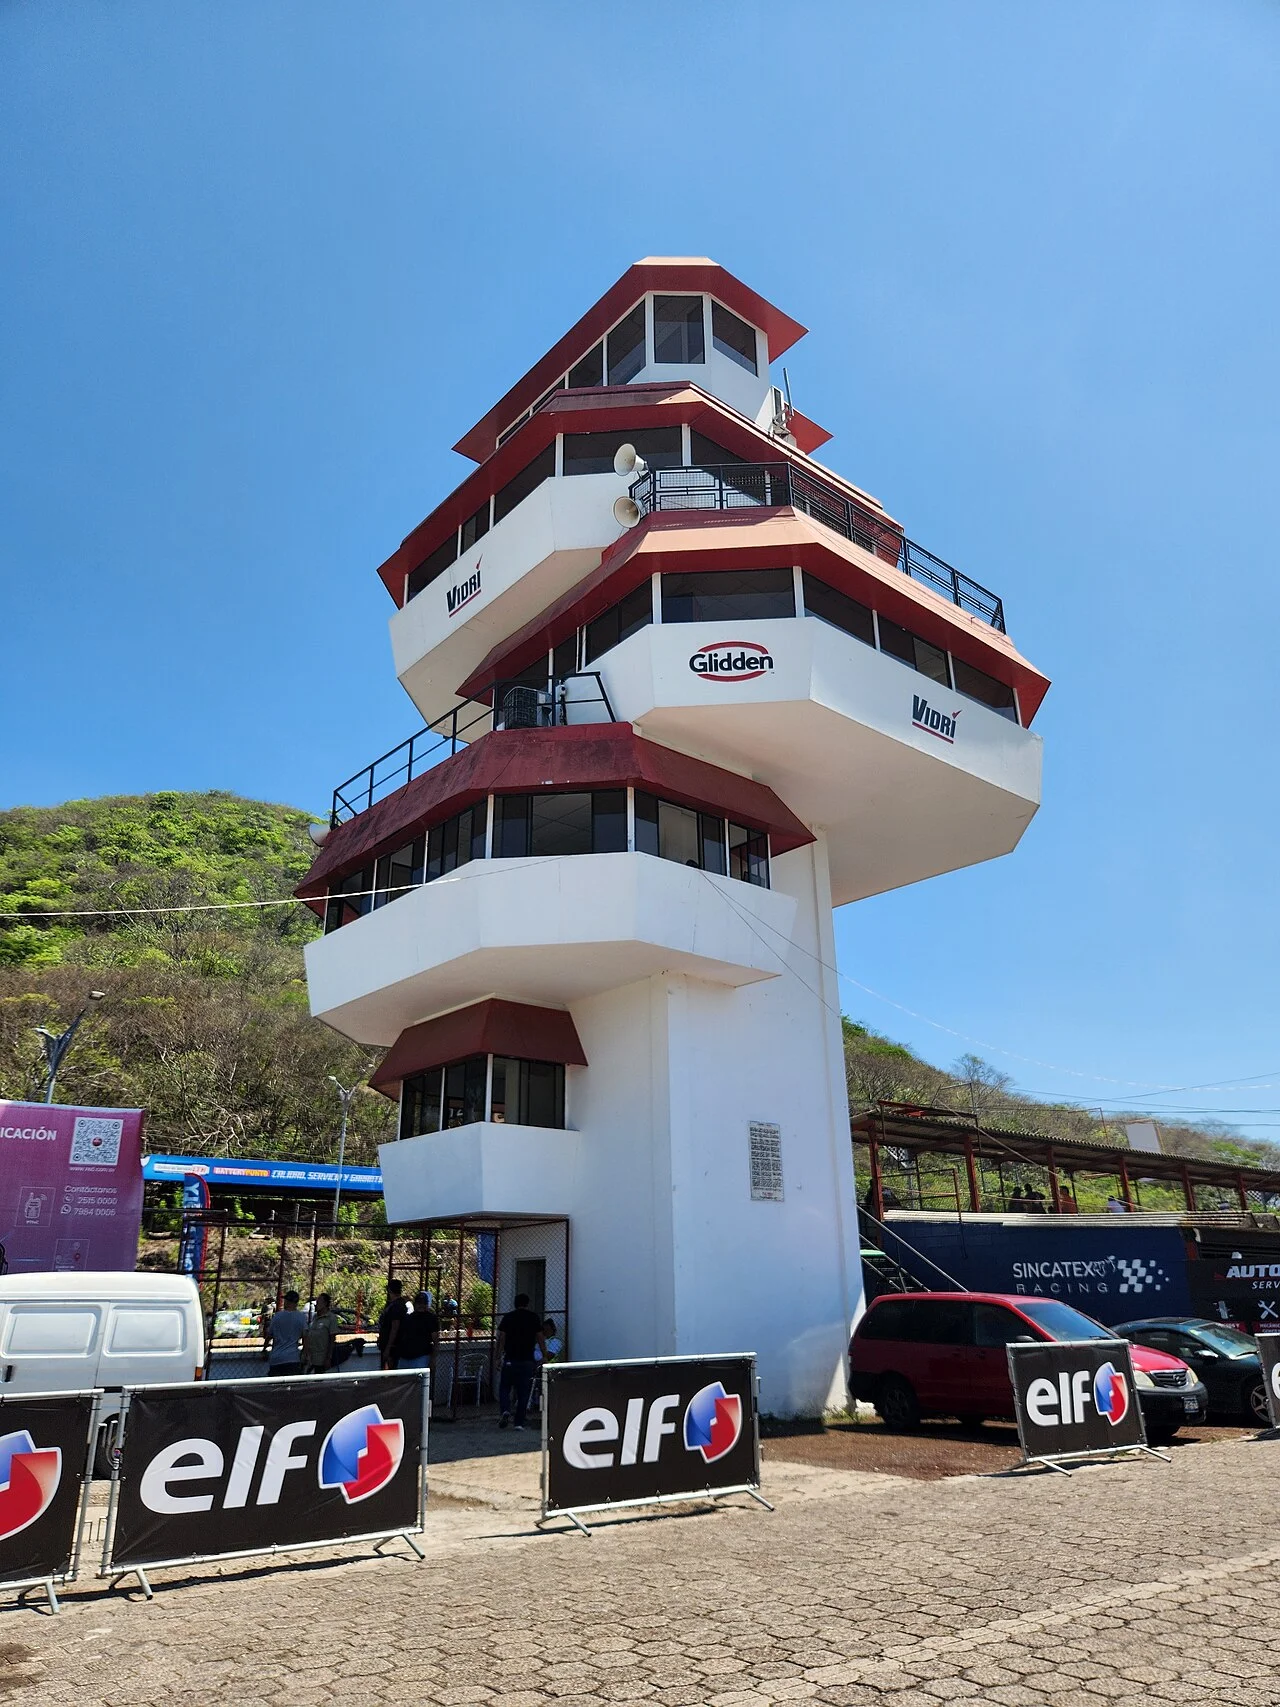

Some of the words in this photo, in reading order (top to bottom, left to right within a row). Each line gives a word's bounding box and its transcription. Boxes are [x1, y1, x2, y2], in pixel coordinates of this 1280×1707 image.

[689, 651, 774, 673] Glidden
[1013, 1261, 1097, 1279] SINCATEX
[1226, 1264, 1280, 1278] AUTO
[1016, 1282, 1108, 1294] RACING
[1252, 1280, 1280, 1290] SERV
[1026, 1370, 1091, 1427] elf
[562, 1394, 680, 1470] elf
[140, 1420, 317, 1515] elf
